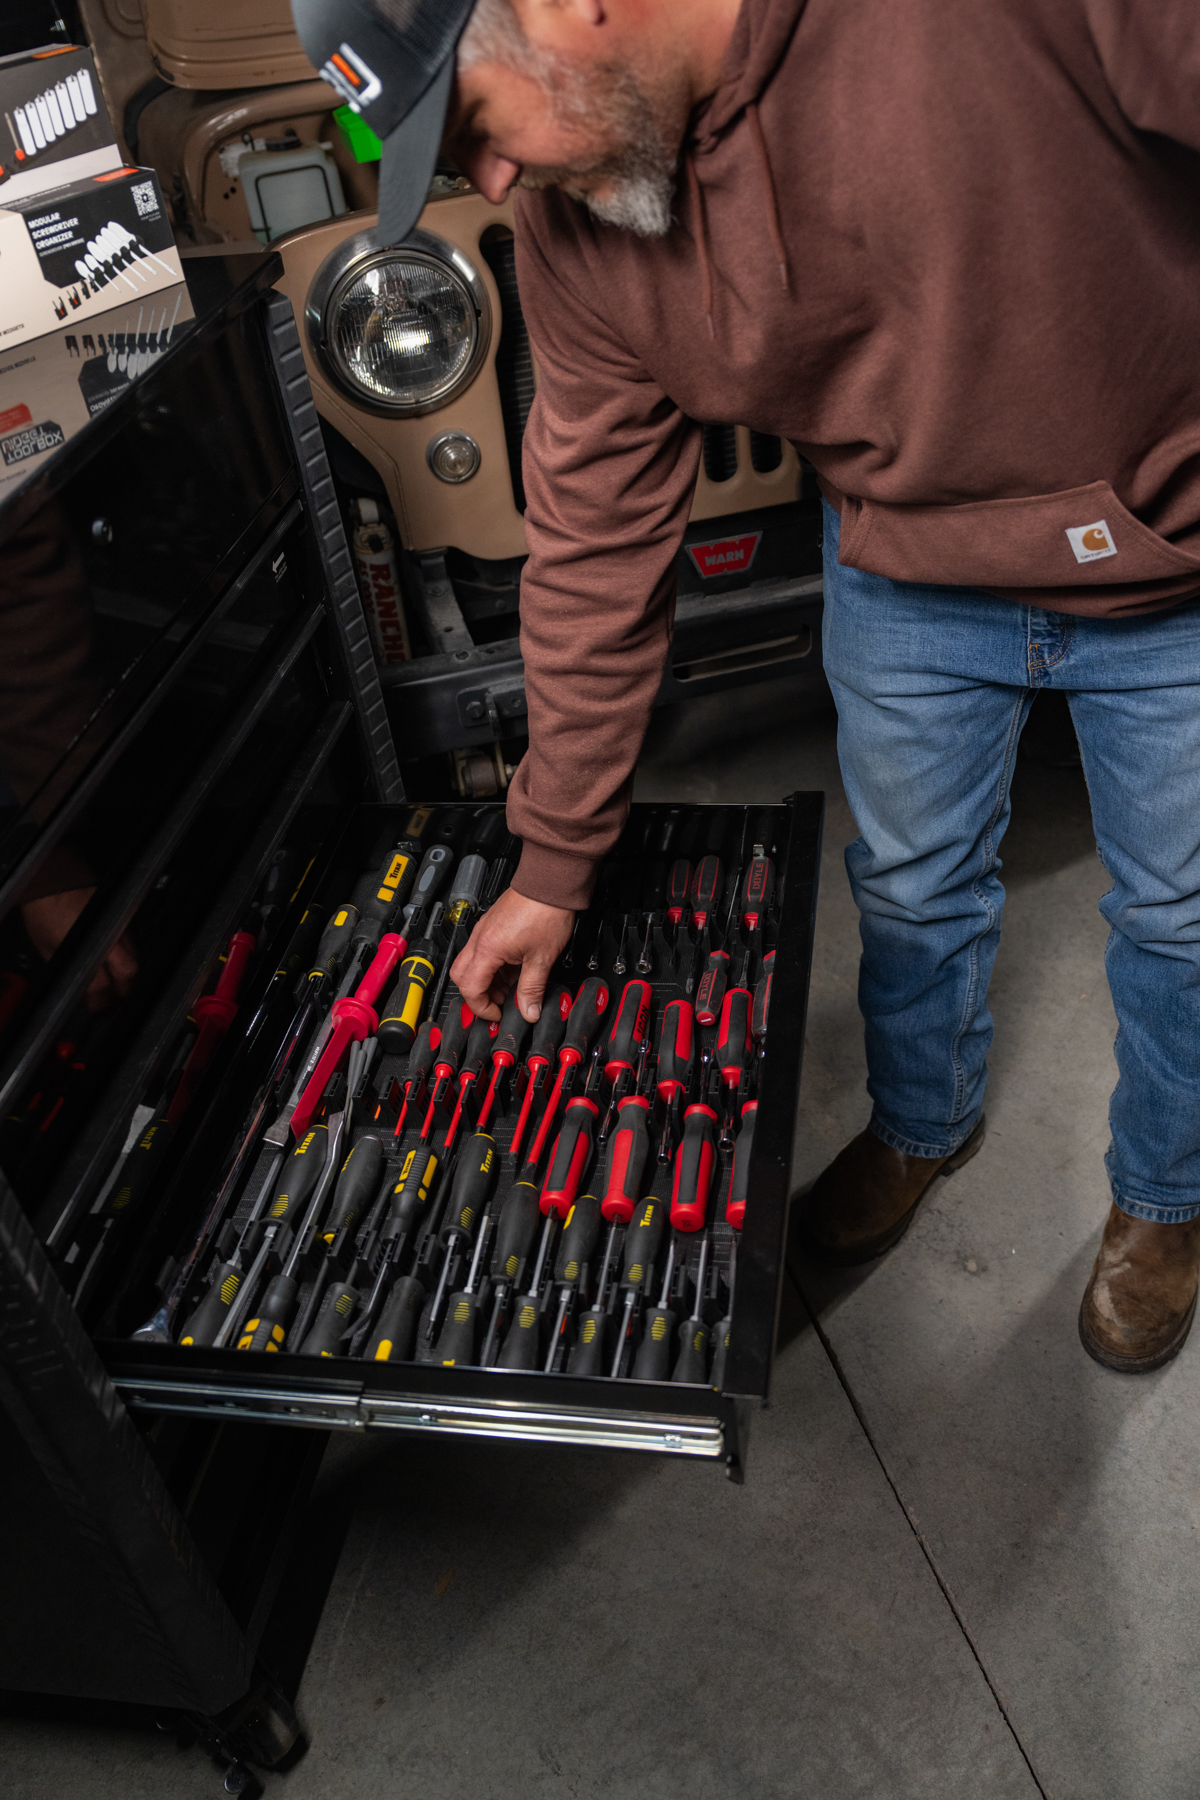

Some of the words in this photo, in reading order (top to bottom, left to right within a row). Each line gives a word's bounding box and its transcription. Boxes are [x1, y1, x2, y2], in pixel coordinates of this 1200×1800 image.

[28, 212, 61, 229] MODULAR
[32, 217, 79, 239] SCREWDRIVER
[36, 230, 74, 250] ORGANIZER
[705, 549, 745, 566] WARN
[752, 862, 765, 890] DOYLE
[700, 972, 713, 1001] DOYLE
